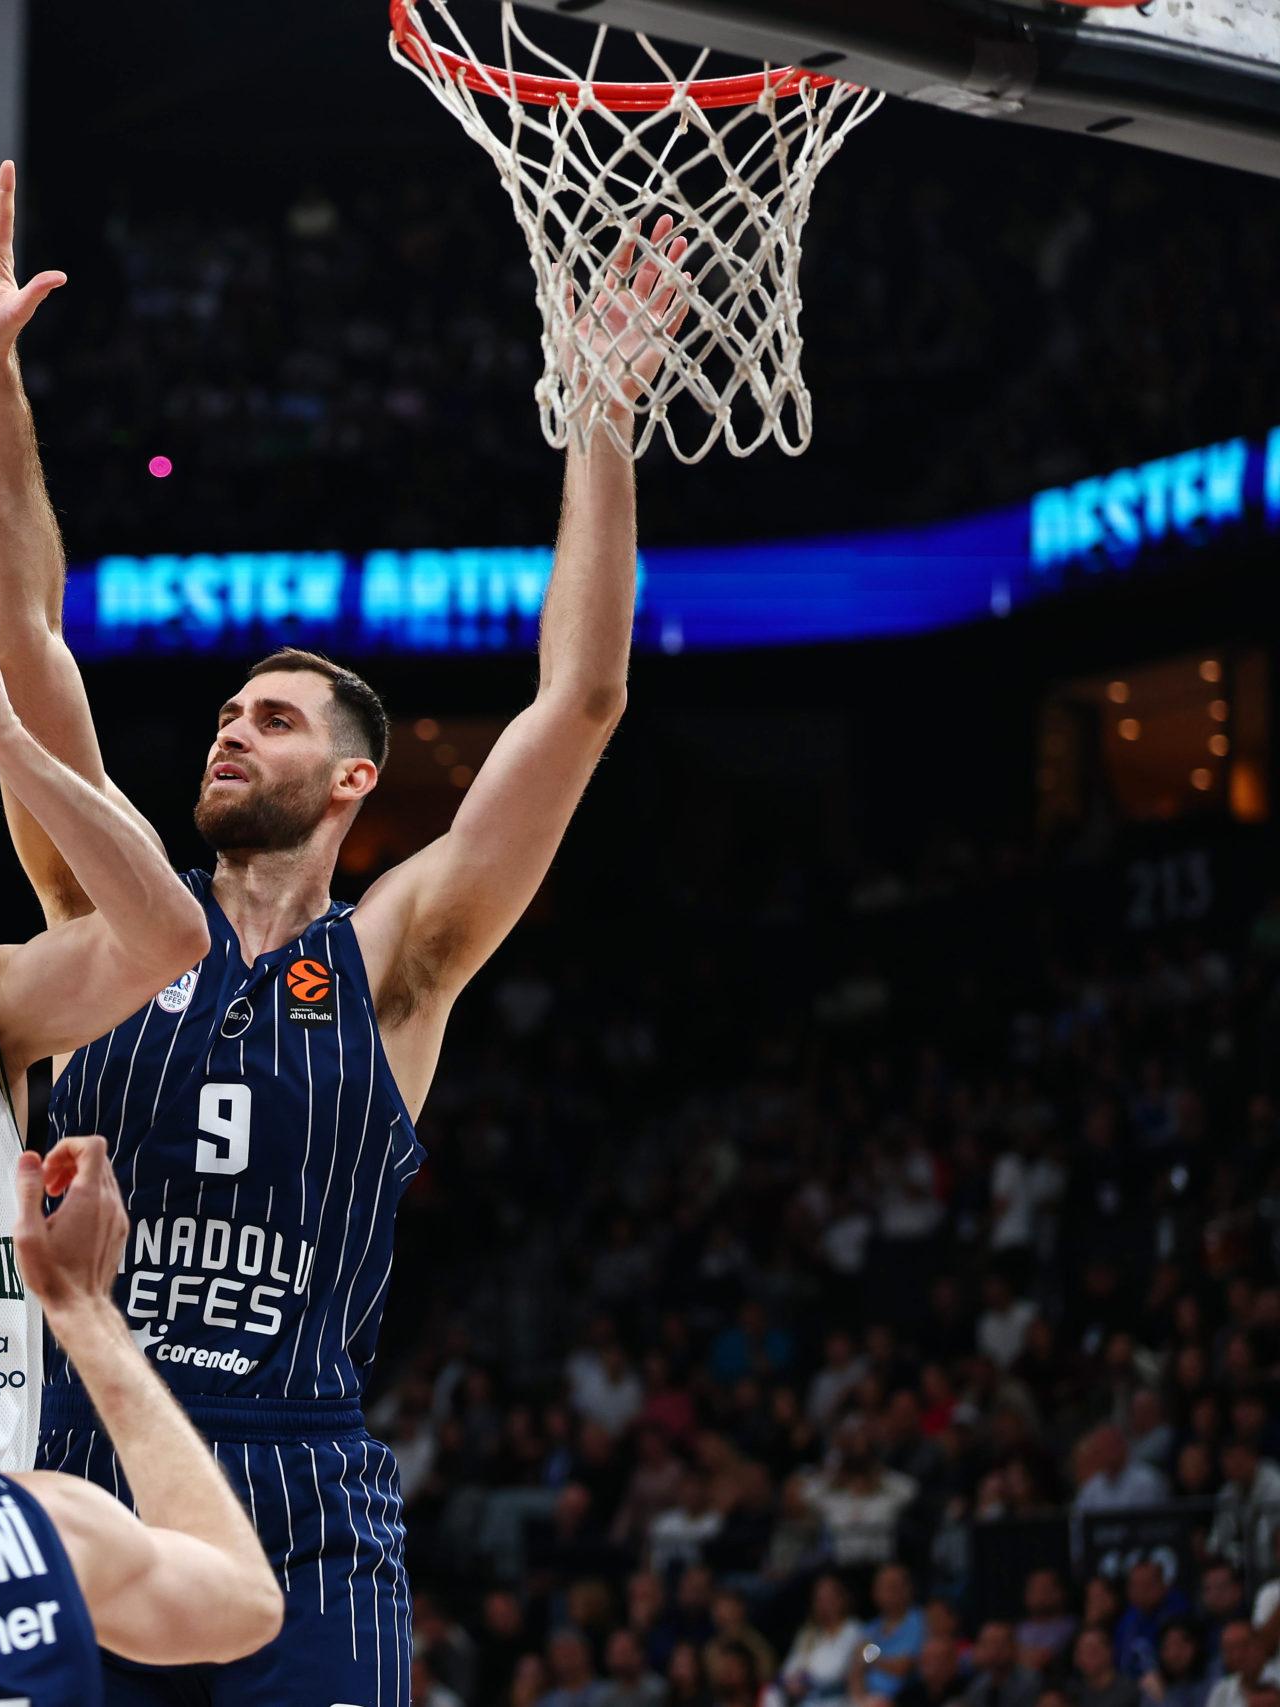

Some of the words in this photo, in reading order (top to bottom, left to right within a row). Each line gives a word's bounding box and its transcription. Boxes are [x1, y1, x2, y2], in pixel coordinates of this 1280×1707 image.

[290, 1011, 307, 1020] abu
[307, 1012, 332, 1021] dhabi
[195, 1083, 252, 1175] 9
[127, 1270, 286, 1336] EFES
